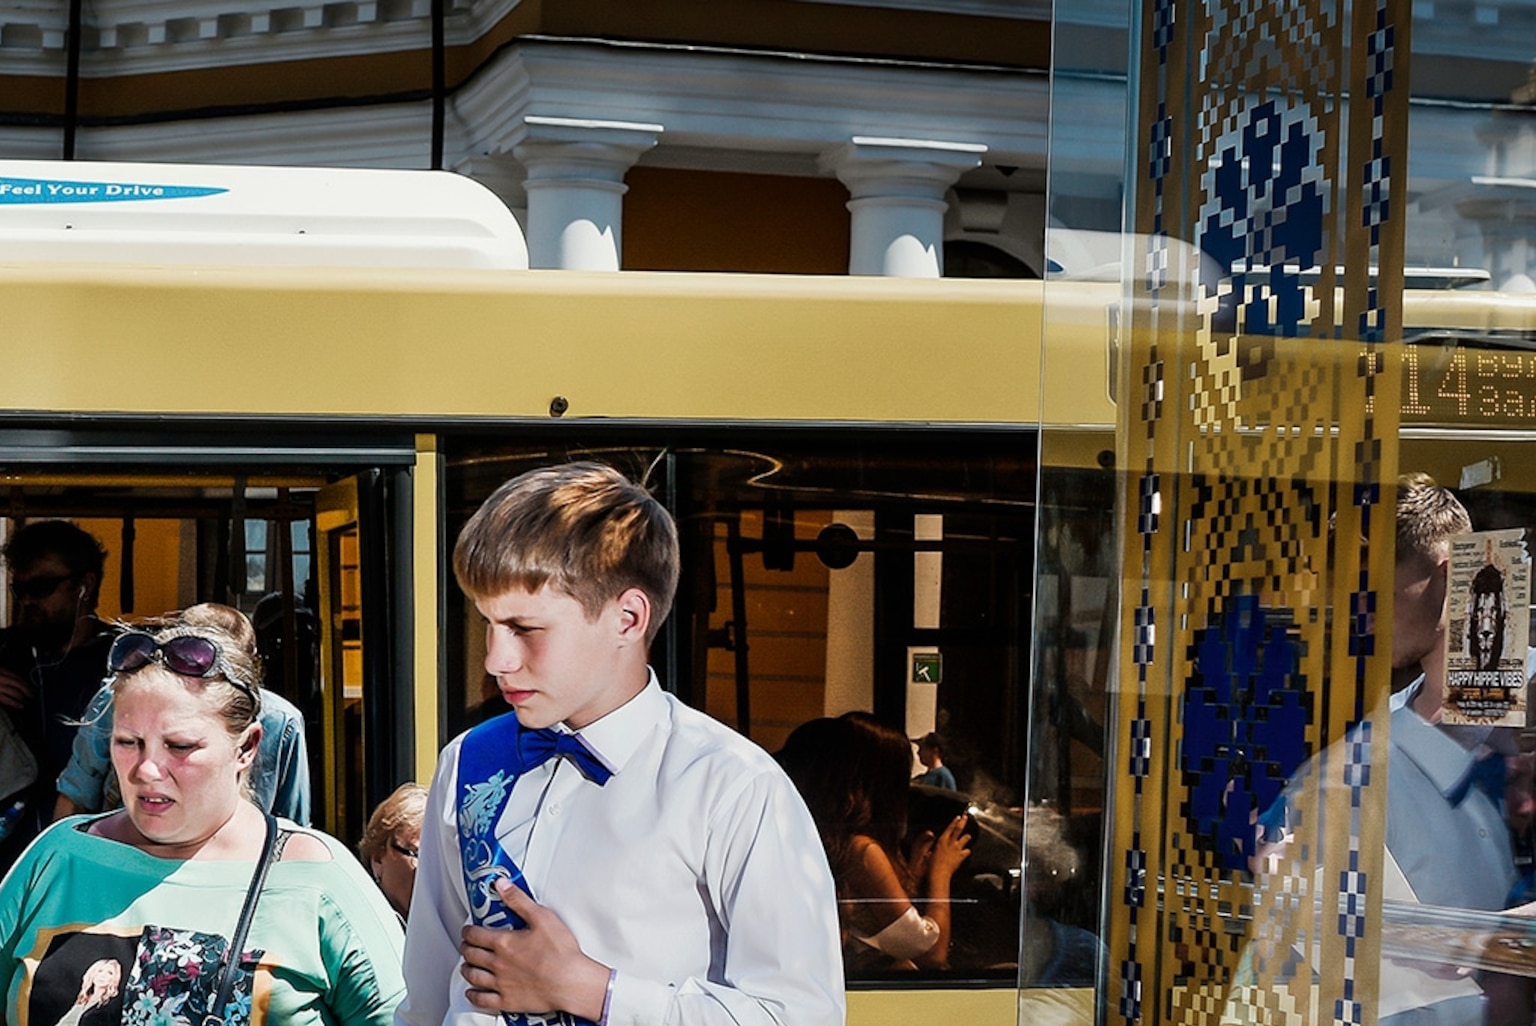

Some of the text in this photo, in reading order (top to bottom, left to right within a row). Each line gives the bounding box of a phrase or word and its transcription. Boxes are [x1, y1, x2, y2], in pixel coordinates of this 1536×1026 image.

[47, 184, 99, 196] Your
[105, 184, 165, 197] Drive
[1447, 671, 1524, 688] HAPPY HIPPIE VIBES
